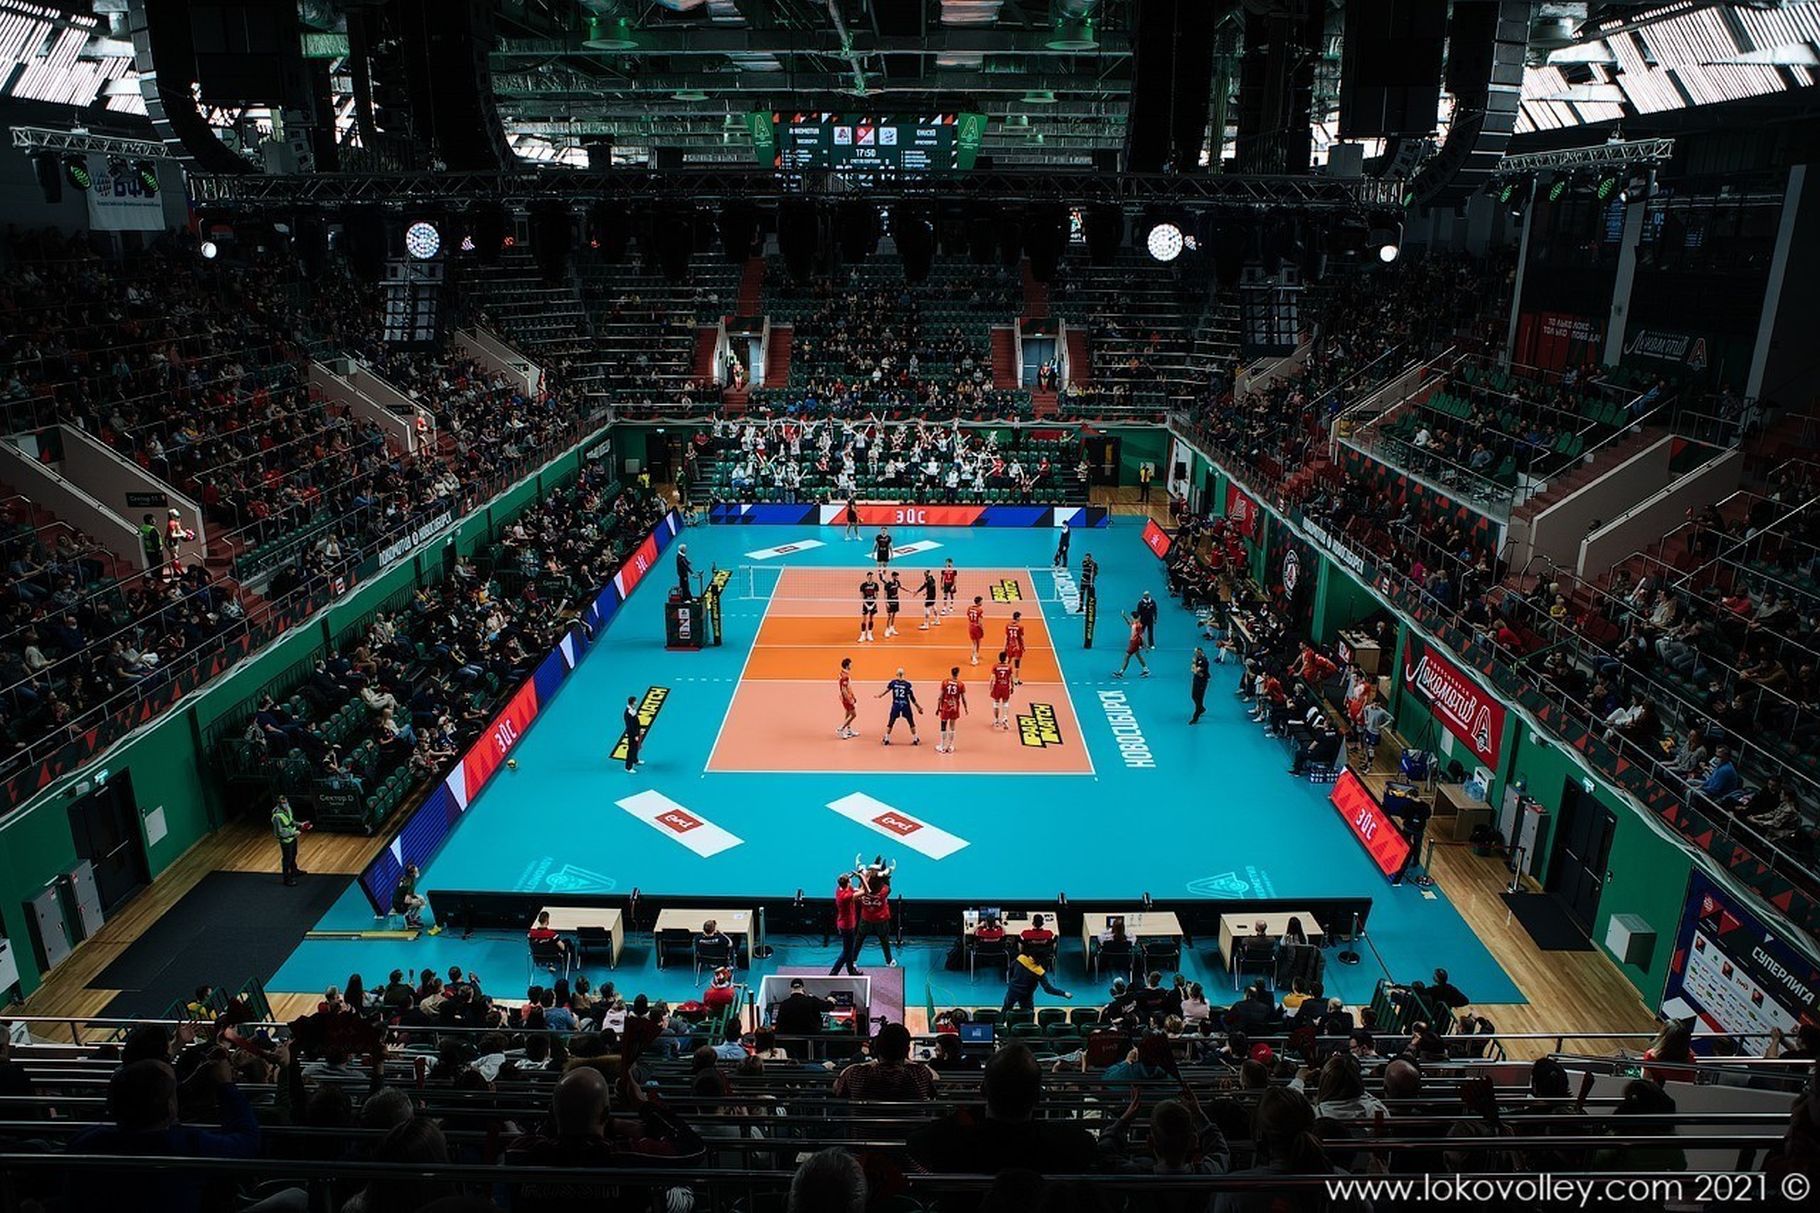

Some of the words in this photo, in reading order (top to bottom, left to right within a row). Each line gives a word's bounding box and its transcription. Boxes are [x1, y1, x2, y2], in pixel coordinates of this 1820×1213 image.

[855, 148, 877, 158] 17:50
[894, 689, 906, 698] 12
[946, 684, 958, 695] 13
[1096, 690, 1157, 768] НОВОСИБИРСК
[1751, 945, 1816, 1006] СУПЕРЛИГА
